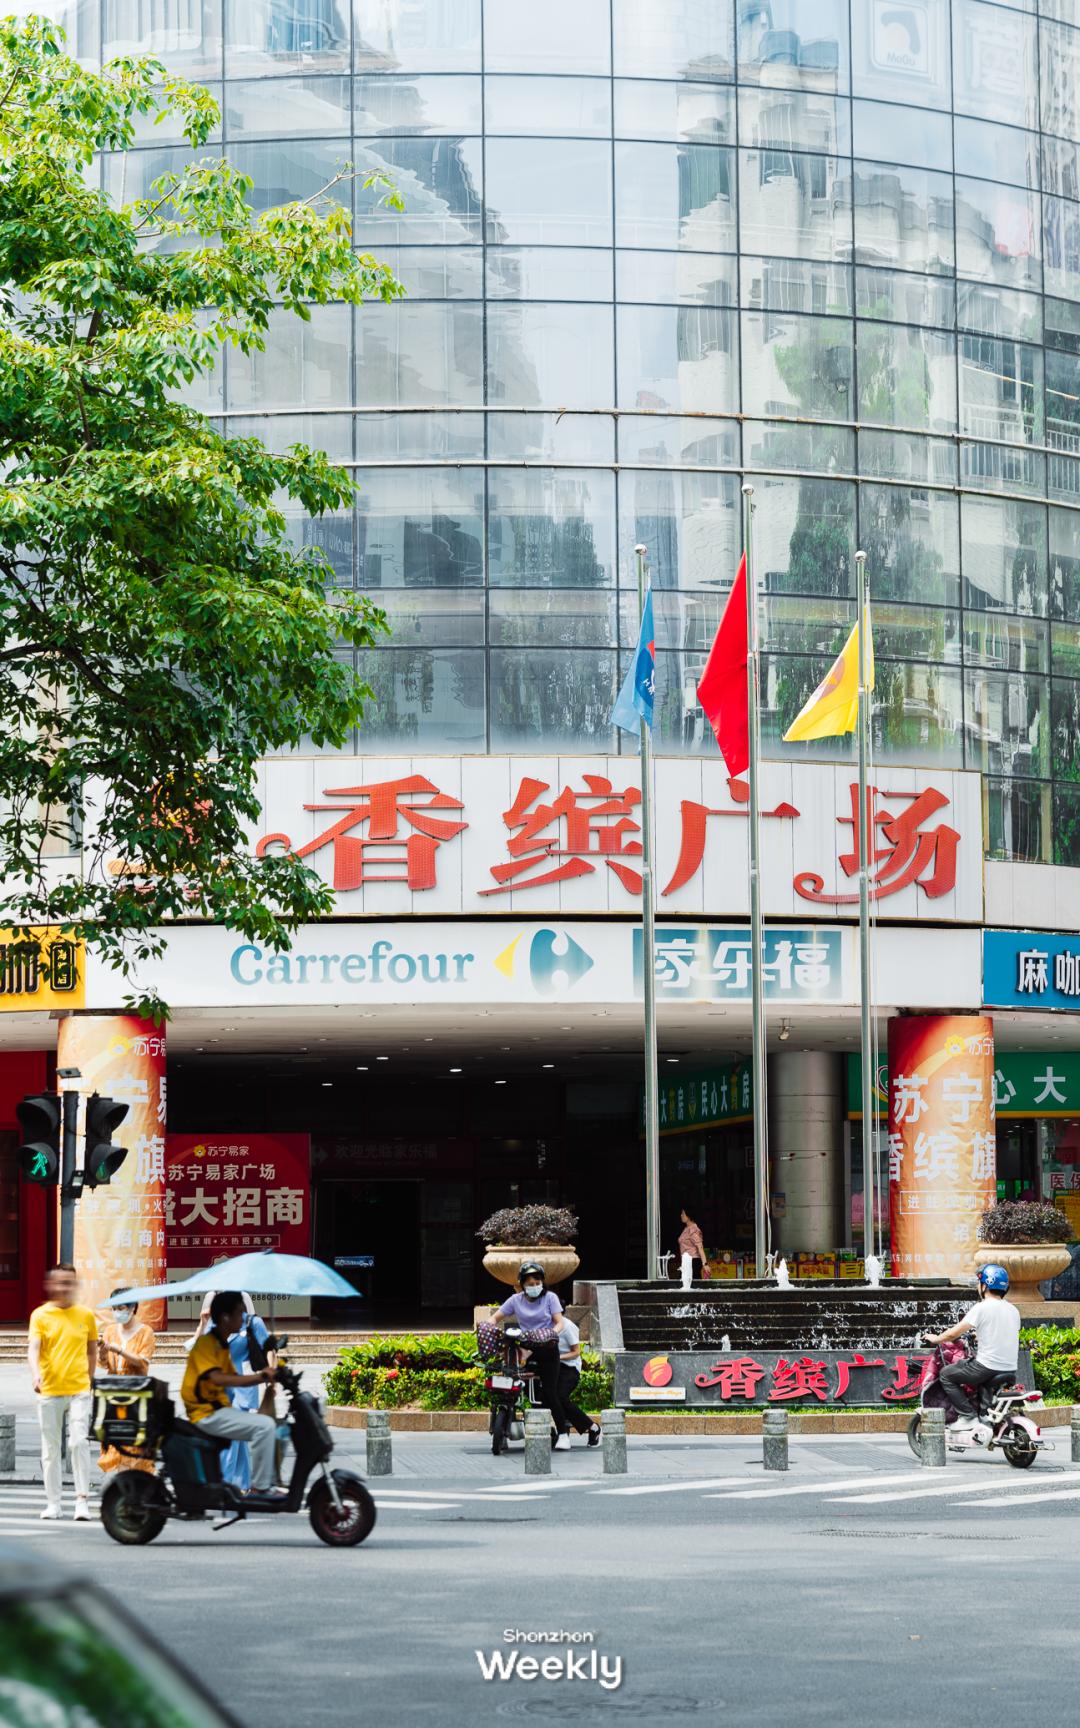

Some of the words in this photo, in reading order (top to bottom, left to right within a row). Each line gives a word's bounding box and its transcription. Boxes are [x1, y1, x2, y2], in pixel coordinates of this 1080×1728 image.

[256, 774, 961, 903] 香缤广场
[230, 939, 475, 986] Carrefour
[654, 939, 831, 990] 家乐福
[168, 1163, 276, 1182] 苏宁易家广场
[207, 1145, 250, 1158] 苏宁易家
